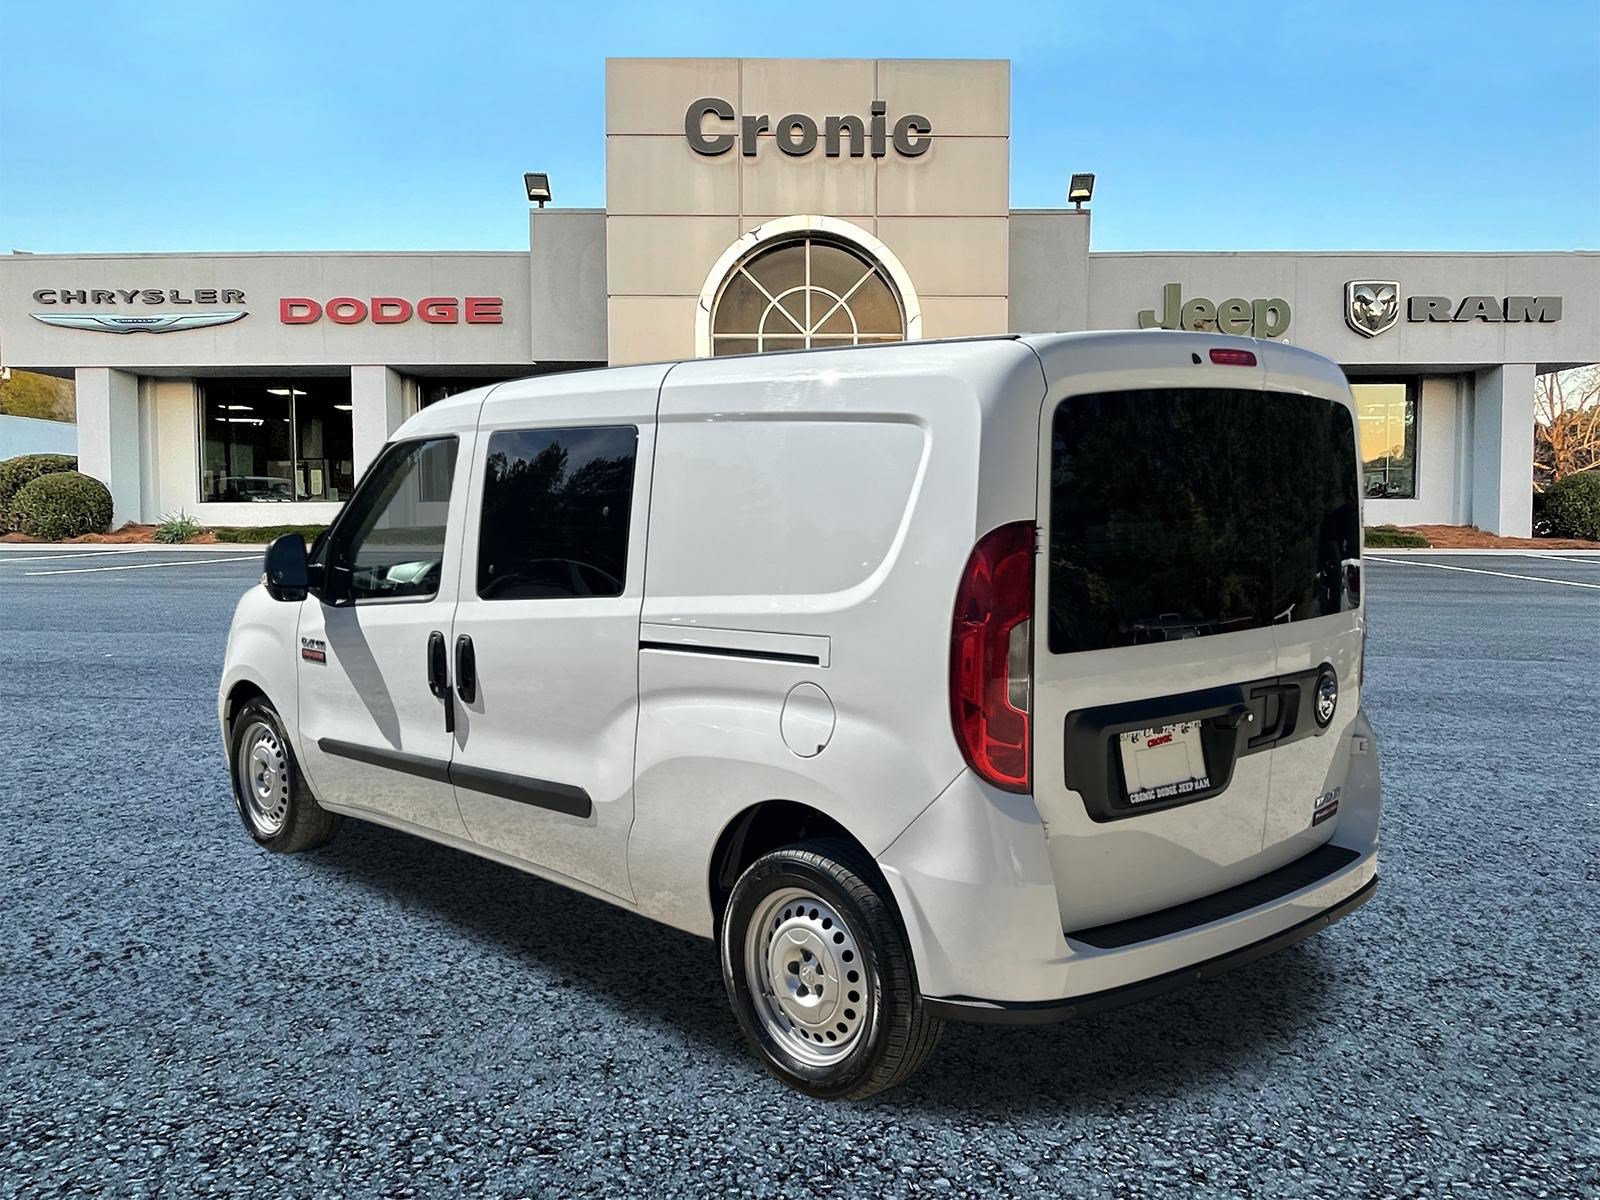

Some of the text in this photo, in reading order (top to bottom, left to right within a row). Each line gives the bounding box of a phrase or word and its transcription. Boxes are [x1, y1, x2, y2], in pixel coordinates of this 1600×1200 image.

[685, 97, 932, 157] Cronic
[32, 288, 246, 304] CHRYSLER
[1408, 296, 1563, 323] RAM
[280, 297, 504, 325] DODGE
[1138, 283, 1292, 339] Jeep
[1147, 734, 1173, 748] CRONIC
[1130, 778, 1210, 804] CRONIC DODGE JEEP RAM
